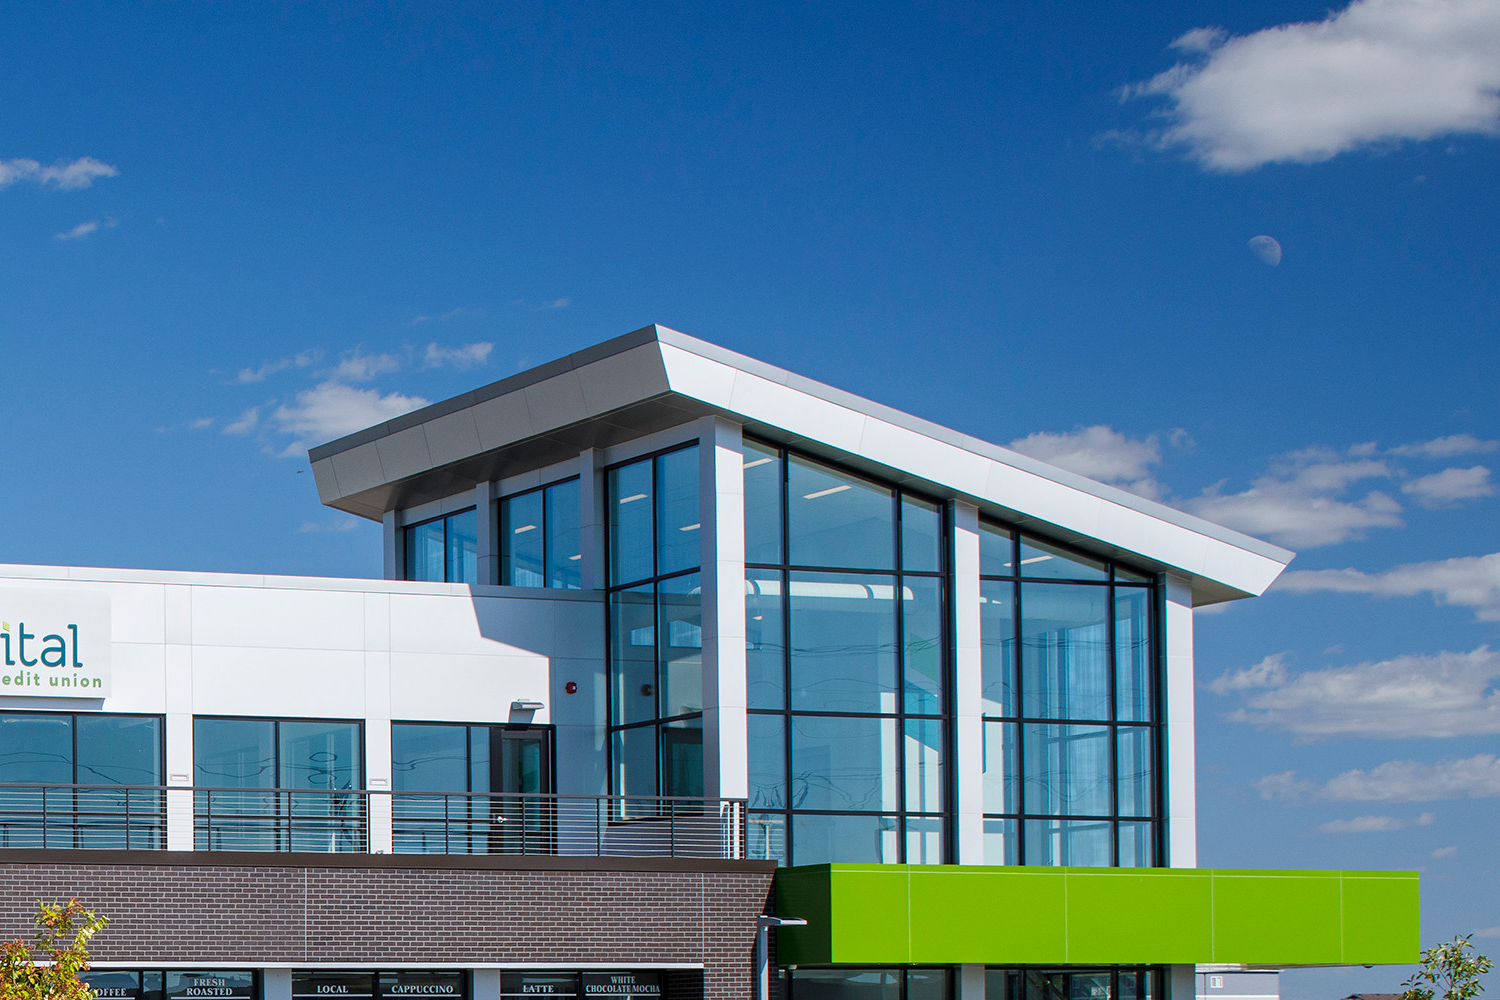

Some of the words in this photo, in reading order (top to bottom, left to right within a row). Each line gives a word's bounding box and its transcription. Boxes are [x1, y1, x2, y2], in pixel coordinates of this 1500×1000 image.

[49, 671, 102, 688] union
[193, 978, 226, 987] FRESH
[611, 976, 636, 984] WHITE
[186, 987, 233, 996] ROASTED
[317, 985, 349, 994] LOCAL
[391, 985, 454, 994] CAPPUCCINO
[522, 985, 554, 993] LATTE
[585, 985, 631, 993] CHOCOLATE
[632, 985, 661, 993] MOCHA
